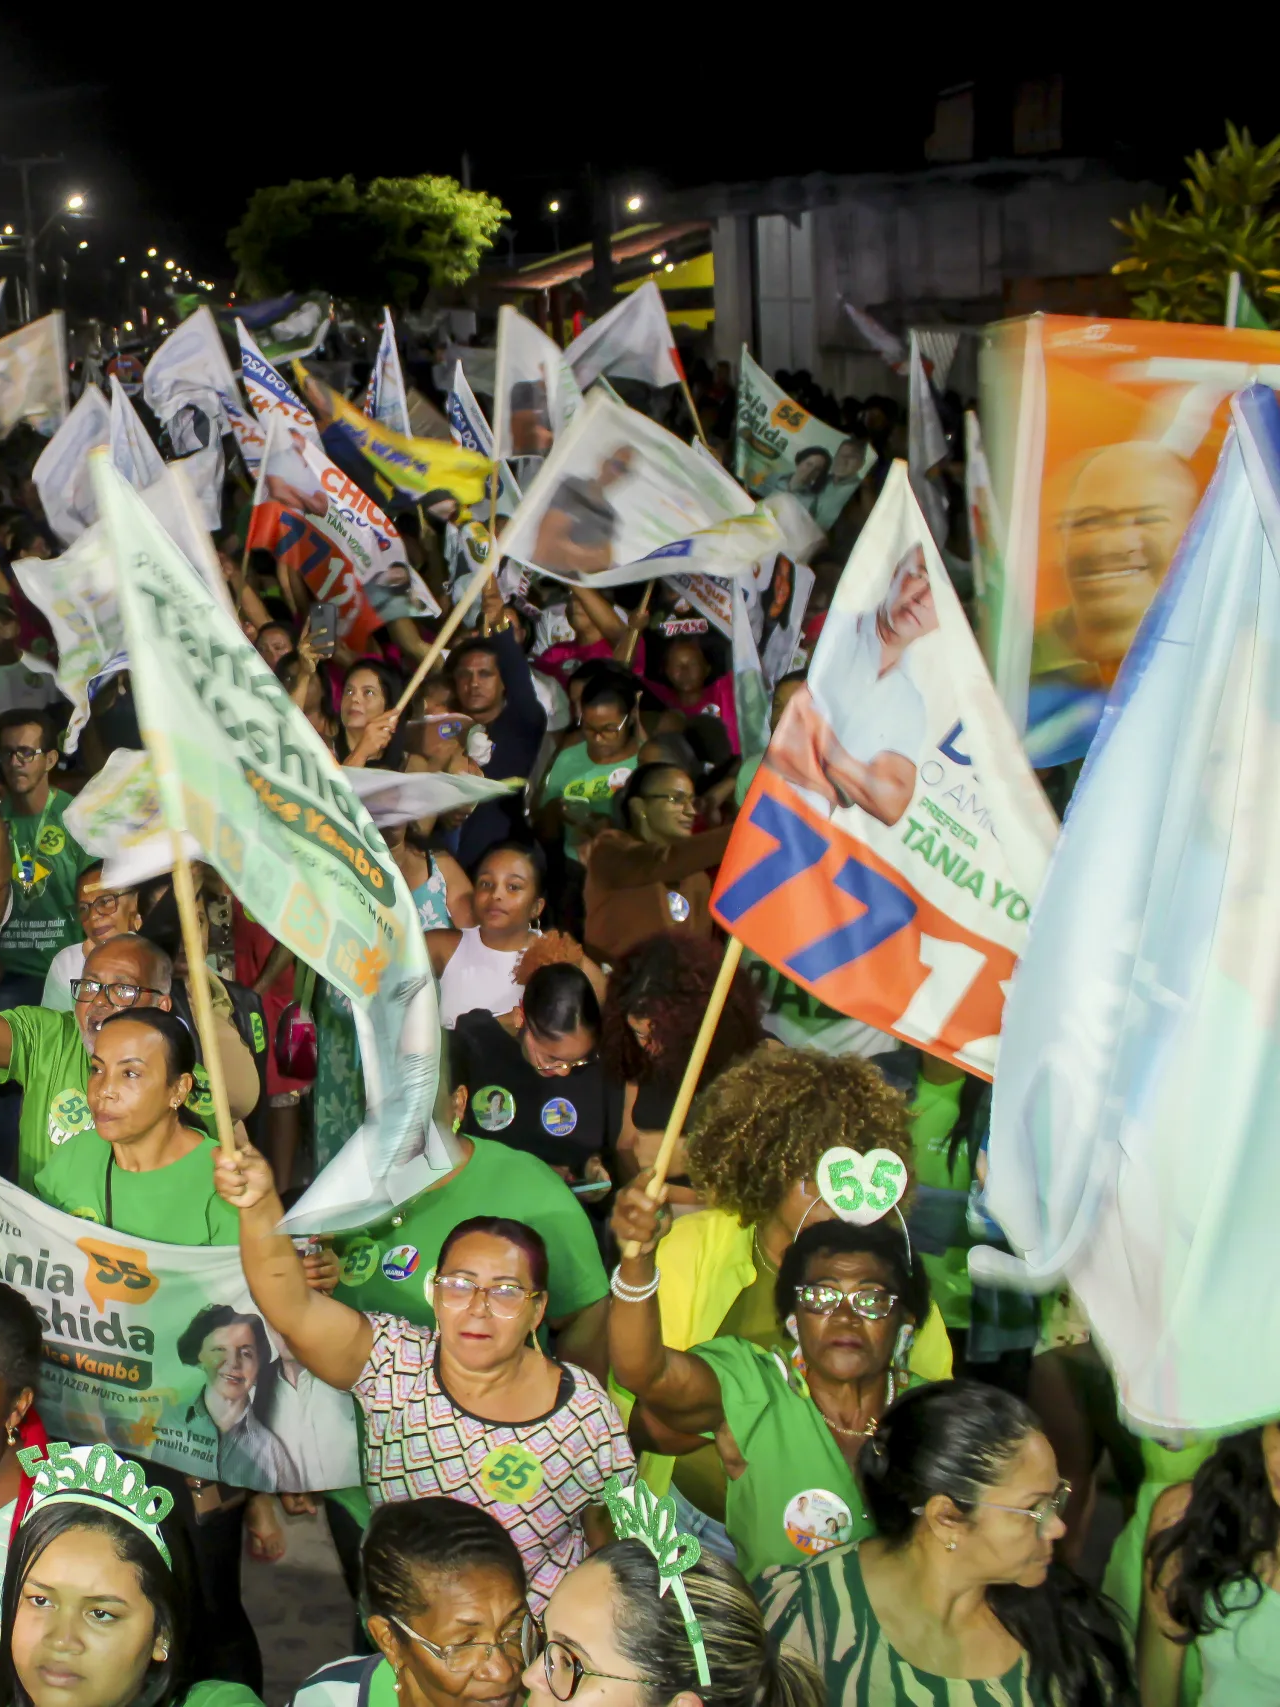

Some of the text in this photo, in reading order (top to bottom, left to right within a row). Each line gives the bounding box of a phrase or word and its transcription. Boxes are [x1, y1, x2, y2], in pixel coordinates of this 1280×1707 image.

[777, 404, 806, 428] 55
[320, 467, 401, 539] CHICO
[40, 830, 64, 848] 55
[900, 814, 986, 901] TÂNIA
[58, 1095, 92, 1125] 55
[827, 1157, 903, 1211] 55
[90, 1251, 152, 1290] 55
[343, 1244, 376, 1273] 55
[31, 1297, 155, 1356] shida
[90, 1385, 125, 1403] MUITO
[155, 1436, 216, 1464] muito mais
[186, 1429, 217, 1448] fazer
[15, 1441, 175, 1525] 55000
[488, 1453, 538, 1491] 55
